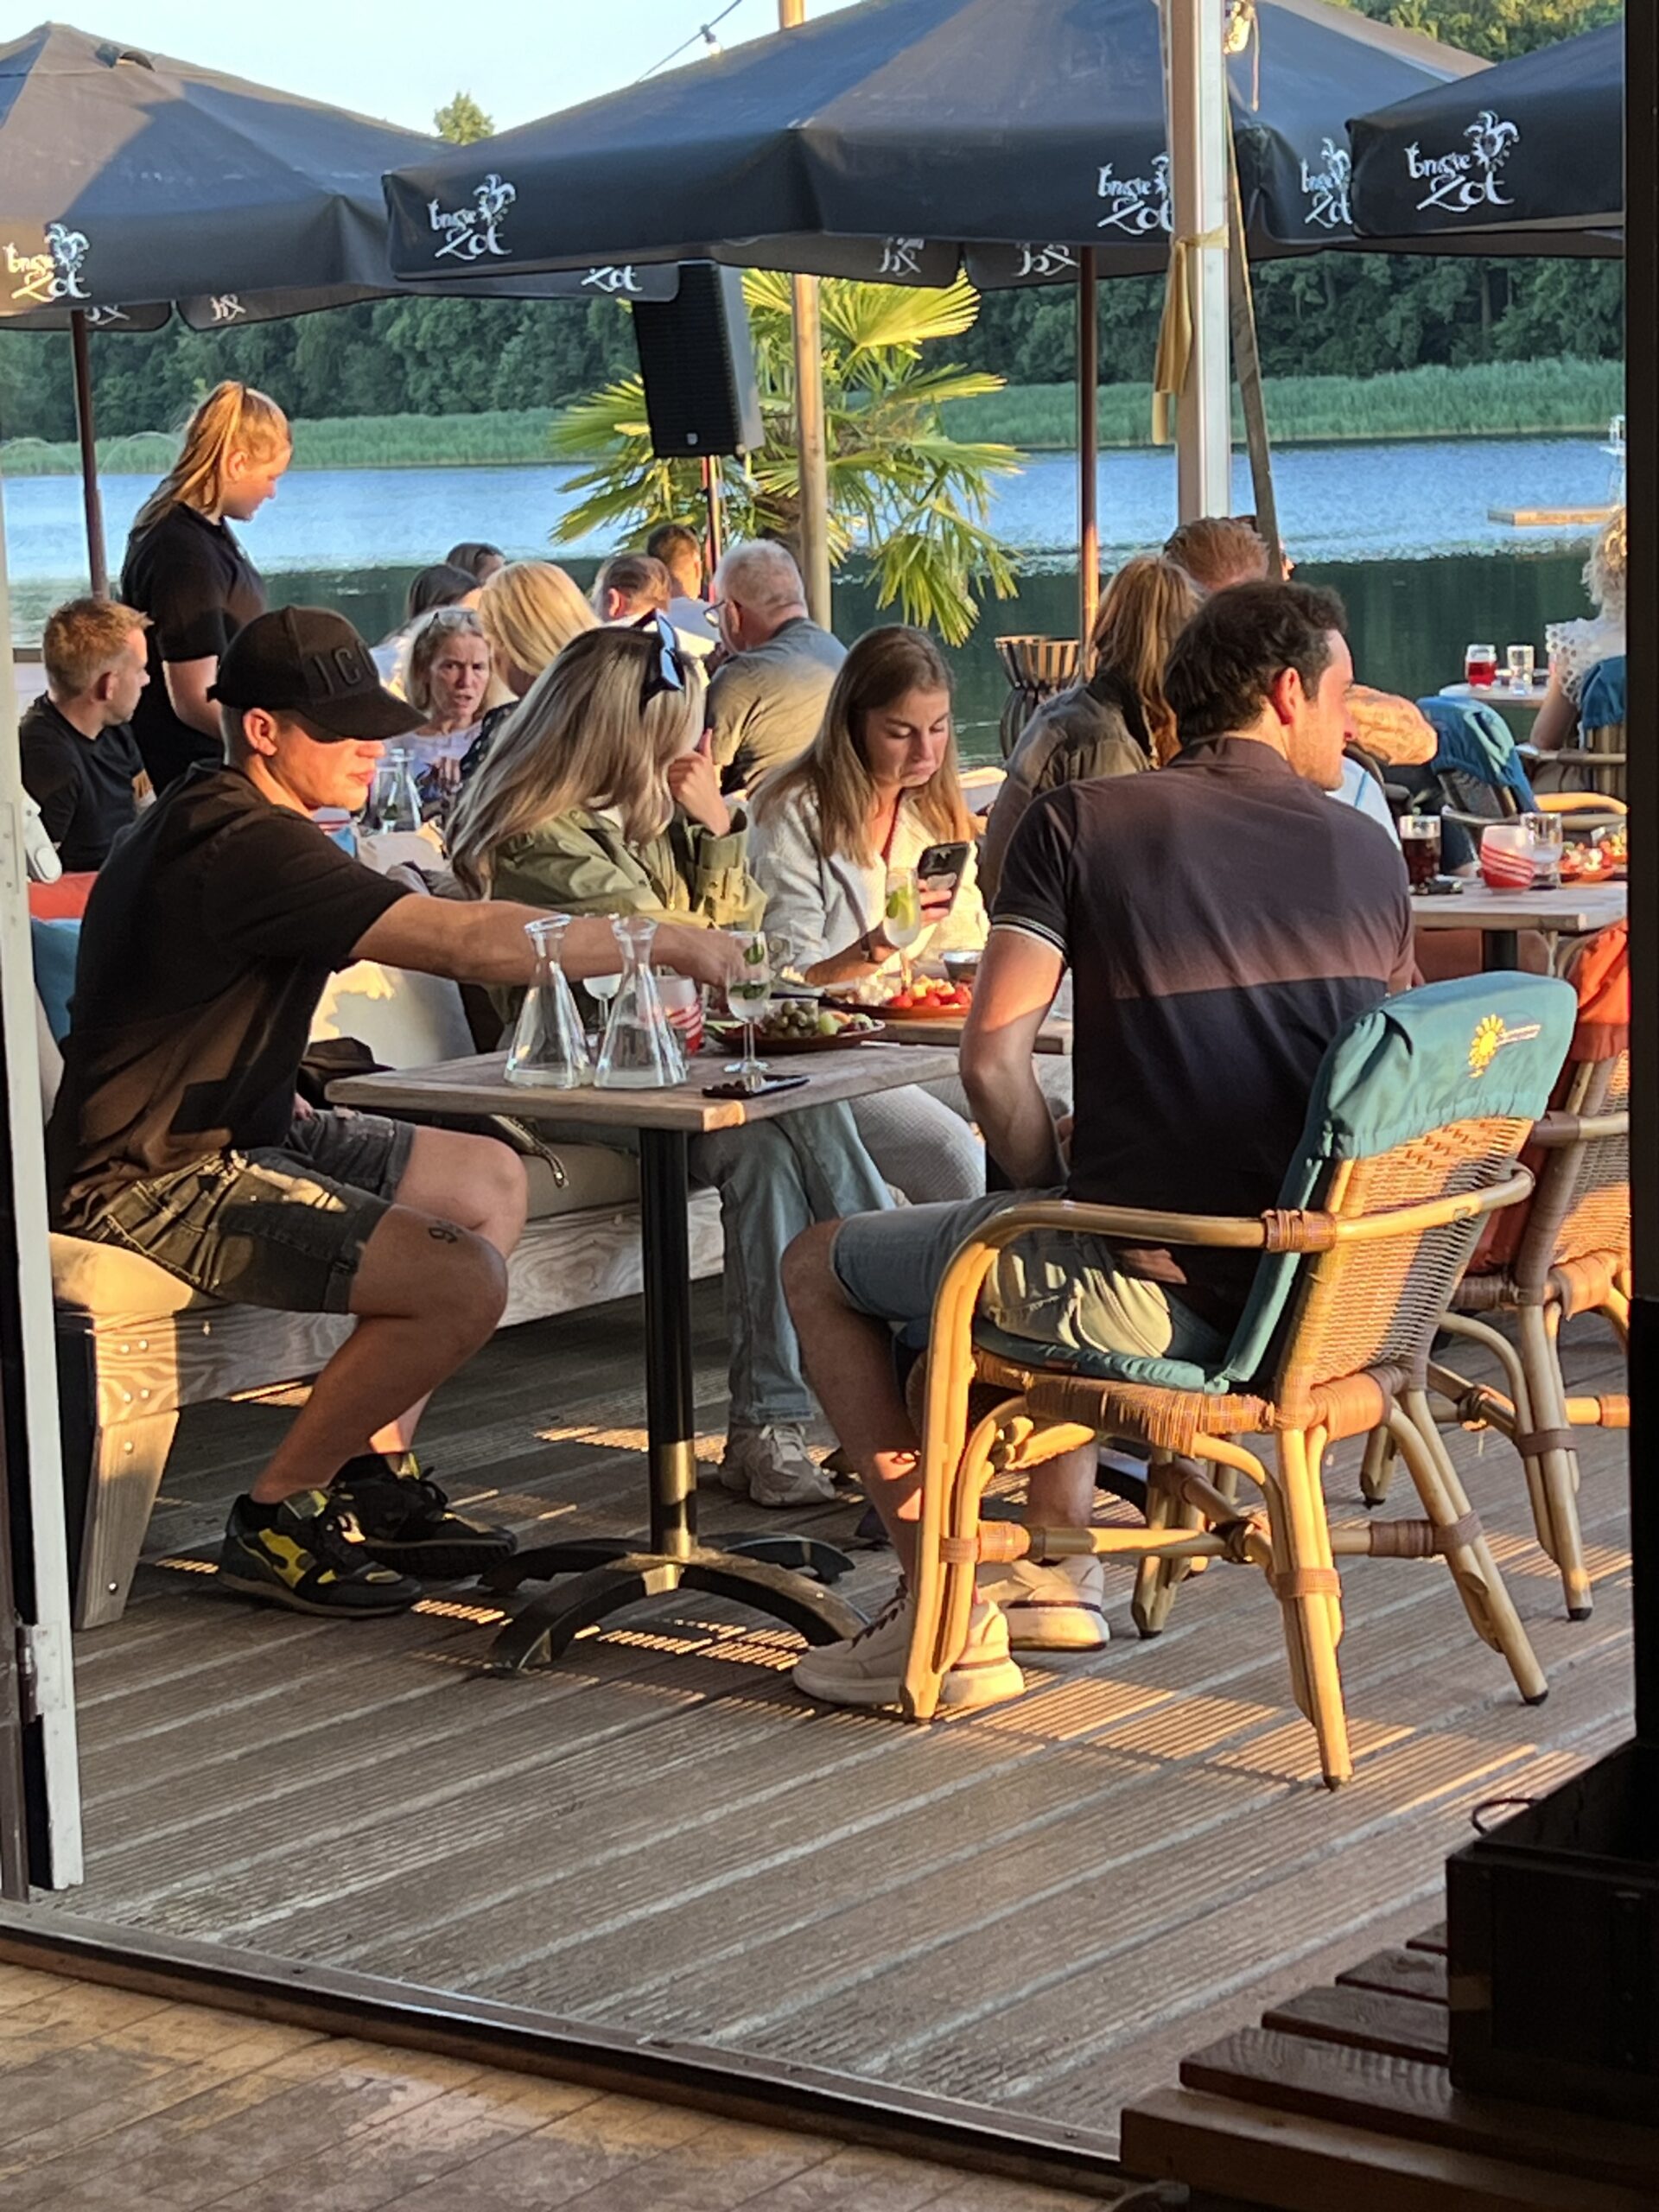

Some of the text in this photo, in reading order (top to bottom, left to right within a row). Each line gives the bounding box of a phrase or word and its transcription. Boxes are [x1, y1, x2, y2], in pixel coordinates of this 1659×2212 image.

[1415, 171, 1515, 213] Zot
[434, 225, 512, 260] Zot
[11, 269, 92, 302] Zot
